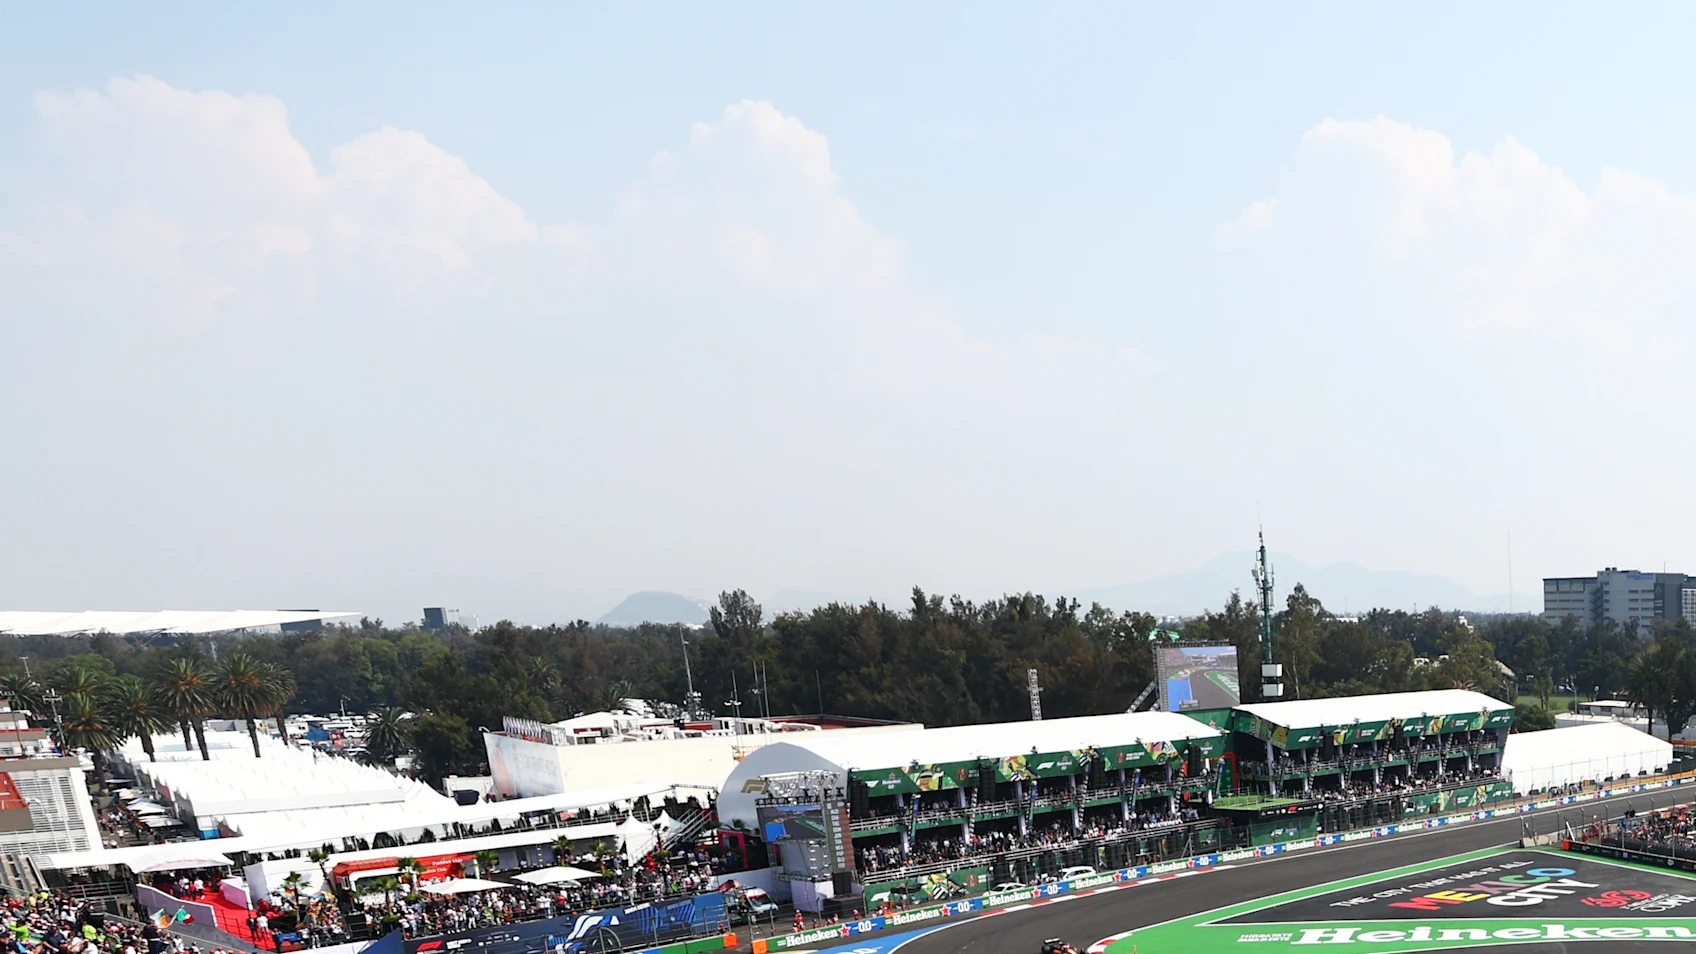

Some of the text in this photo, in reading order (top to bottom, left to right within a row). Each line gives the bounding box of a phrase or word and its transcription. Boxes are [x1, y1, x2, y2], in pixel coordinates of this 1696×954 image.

[1152, 859, 1187, 874] Heineken
[1075, 873, 1114, 889] Heineken
[1387, 866, 1577, 912] MEXICO
[989, 889, 1032, 906] Heineken
[1486, 877, 1600, 907] CITY
[1329, 896, 1377, 908] THE
[893, 905, 940, 926] Heineken
[786, 927, 838, 948] Heineken
